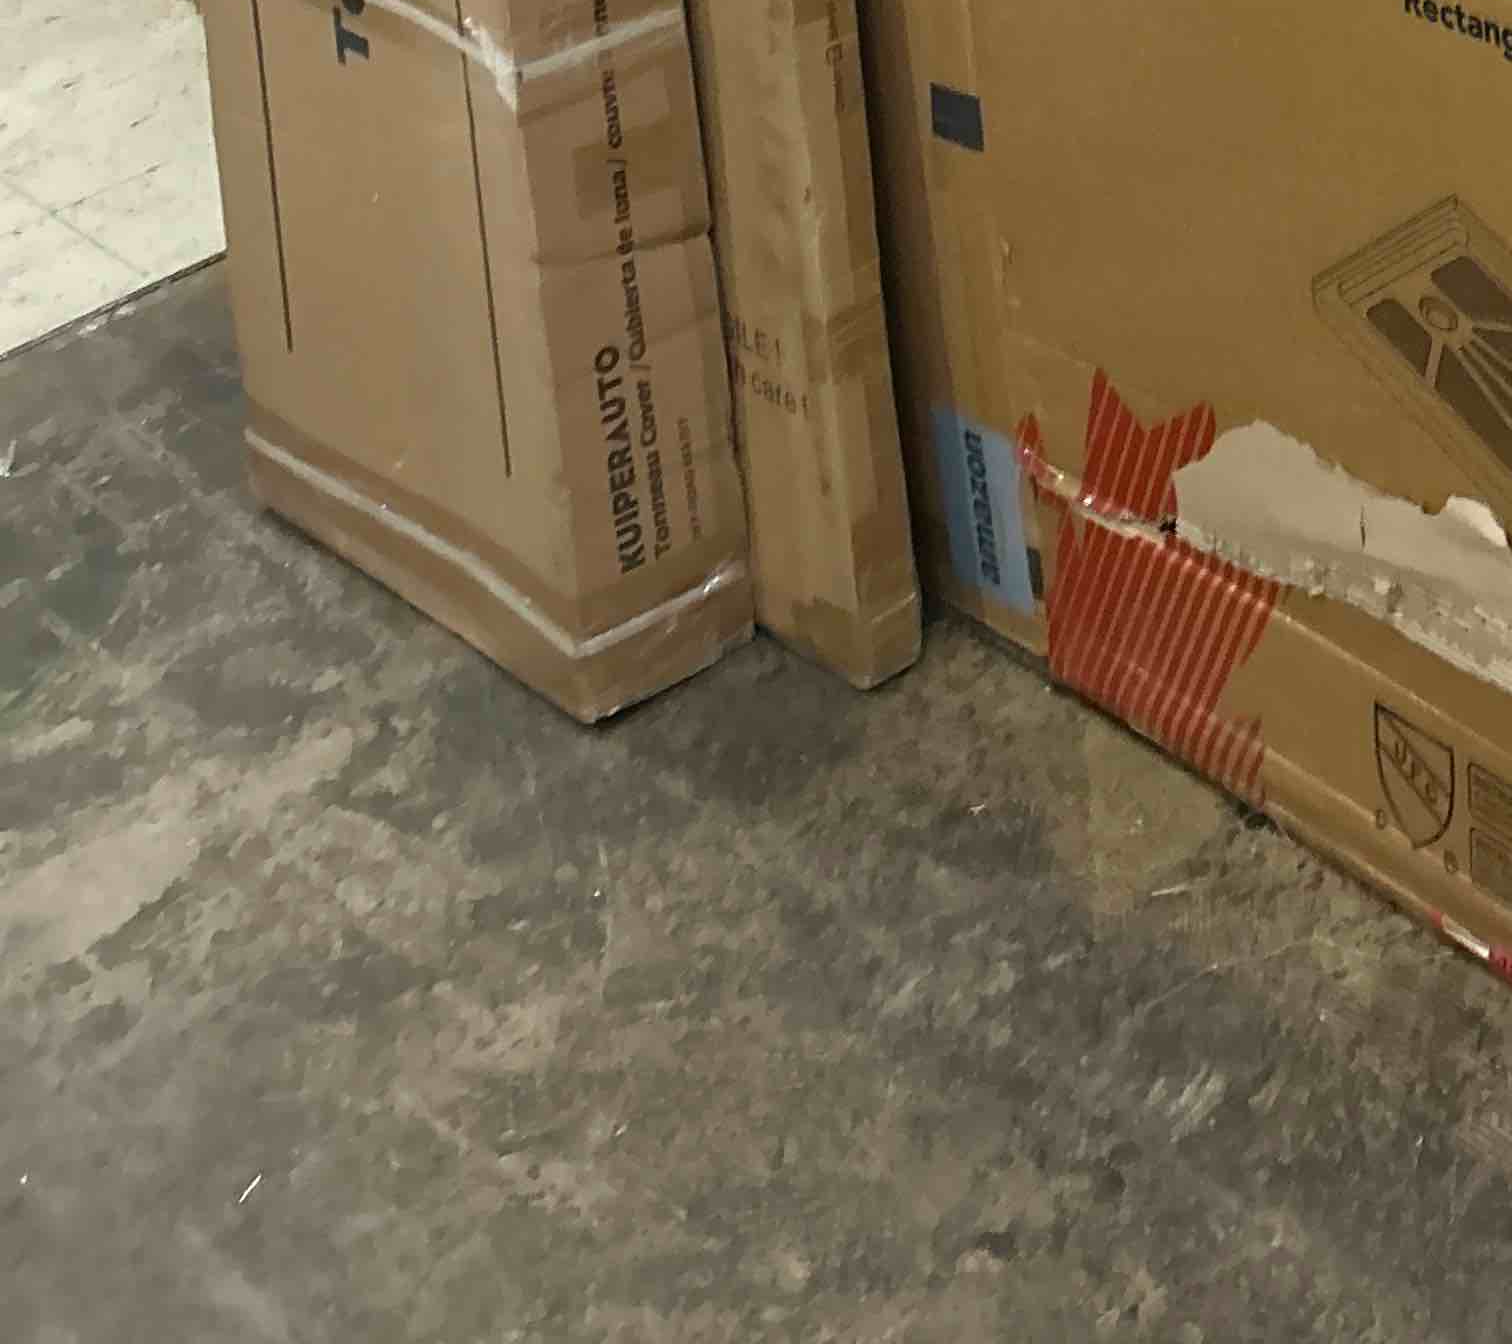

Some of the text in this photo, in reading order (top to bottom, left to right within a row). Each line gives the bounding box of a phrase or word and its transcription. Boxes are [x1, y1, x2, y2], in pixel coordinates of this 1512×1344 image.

[592, 345, 646, 576] KUIPERAUTO
[633, 380, 657, 448] Cover
[640, 450, 672, 561] Tonneau
